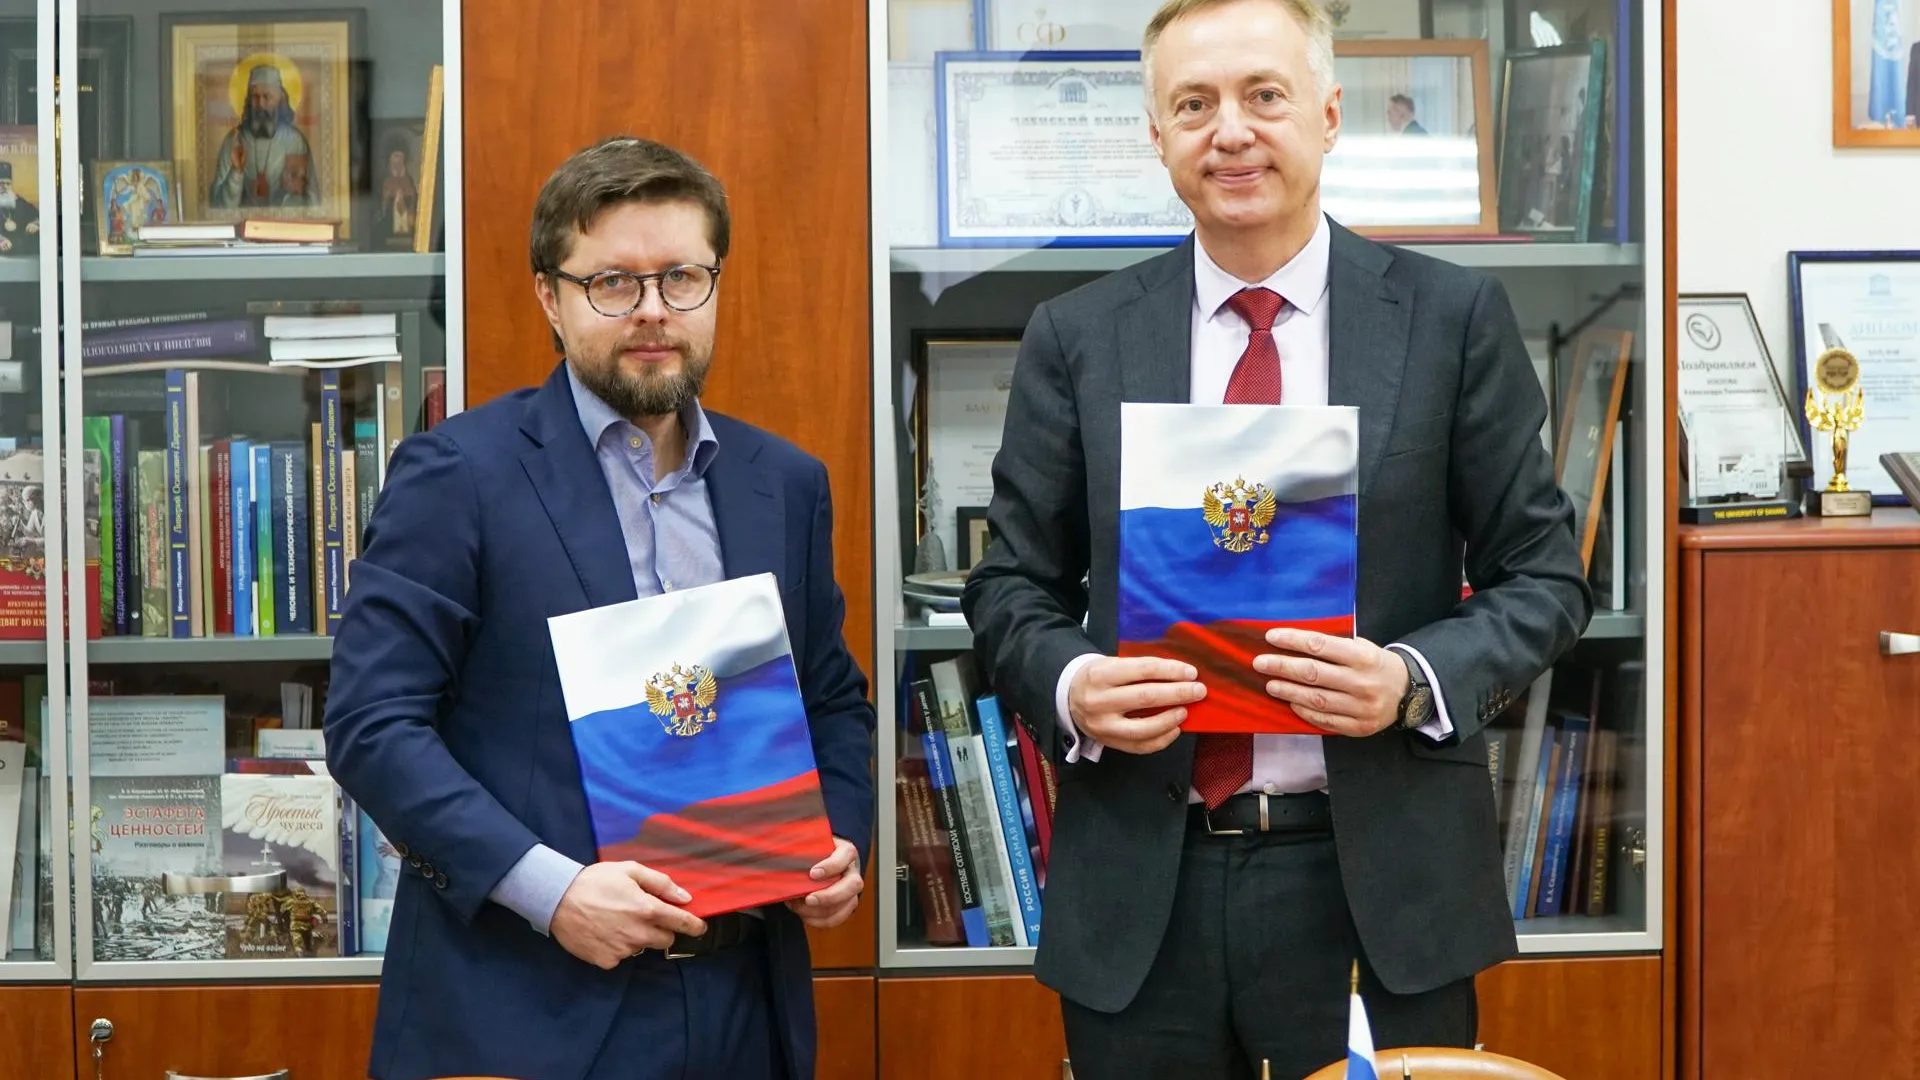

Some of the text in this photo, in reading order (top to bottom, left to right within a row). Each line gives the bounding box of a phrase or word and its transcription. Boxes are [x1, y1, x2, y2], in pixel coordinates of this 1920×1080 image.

[1094, 116, 1140, 126] БИЛЕТ
[285, 453, 293, 493] ПРОГРЕСС
[1714, 511, 1725, 519] THE
[1725, 509, 1756, 518] UNIVERSITY
[1757, 508, 1764, 516] OF
[286, 494, 295, 575] ТЕХНОЛОГИЧЕСКИЙ
[115, 551, 125, 624] МЕДИЦИНСКАЯ
[289, 586, 297, 621] ЧЕЛОВЕК
[986, 717, 1002, 761] СТРАНА
[245, 794, 322, 828] Простые
[998, 764, 1015, 823] КРАСИВАЯ
[110, 823, 204, 837] ЦЕННОСТЕЙ
[125, 806, 204, 818] ЭСТАФЕТА
[280, 821, 323, 832] чудеса
[950, 831, 964, 867] ОПУХОЛИ
[1010, 826, 1024, 865] САМАЯ
[958, 867, 972, 904] КОСТНЫЕ
[1019, 868, 1035, 912] РОССИЯ
[240, 943, 255, 952] Чудо
